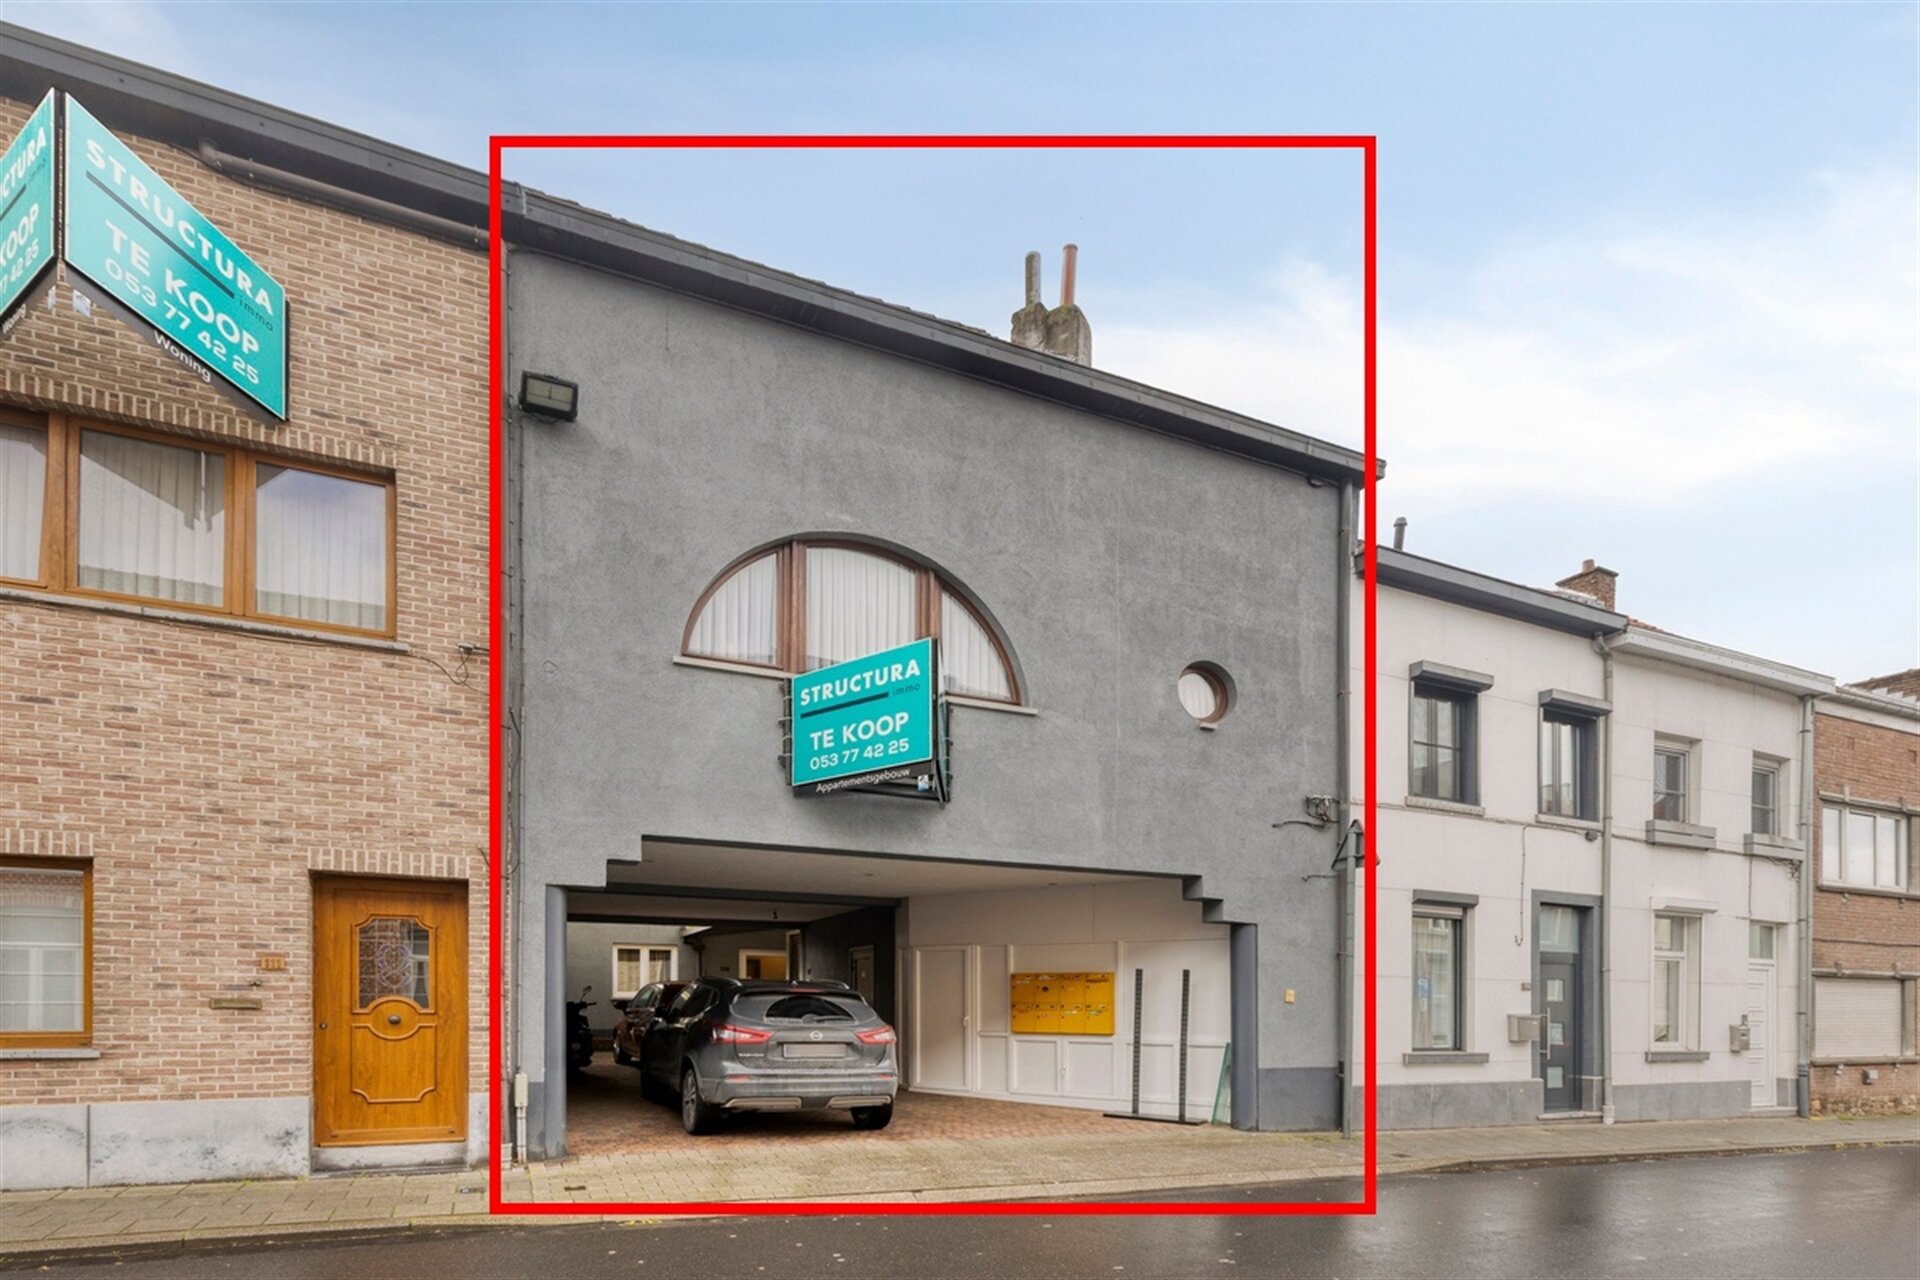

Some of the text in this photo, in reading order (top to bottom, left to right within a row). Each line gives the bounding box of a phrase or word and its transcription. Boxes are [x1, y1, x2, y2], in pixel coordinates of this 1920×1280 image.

[0, 126, 46, 197] CTURA
[86, 138, 274, 316] STRUCTURA
[105, 219, 259, 354] TE KOOP
[104, 257, 260, 385] 053 77 42 25
[239, 295, 274, 332] immo
[154, 329, 212, 383] Woning
[800, 658, 921, 707] STRUCTURA
[892, 683, 921, 697] immo
[809, 711, 910, 751] TE KOOP
[810, 738, 910, 771] 053 77 42 25
[815, 768, 912, 794] Appartementsgebouw
